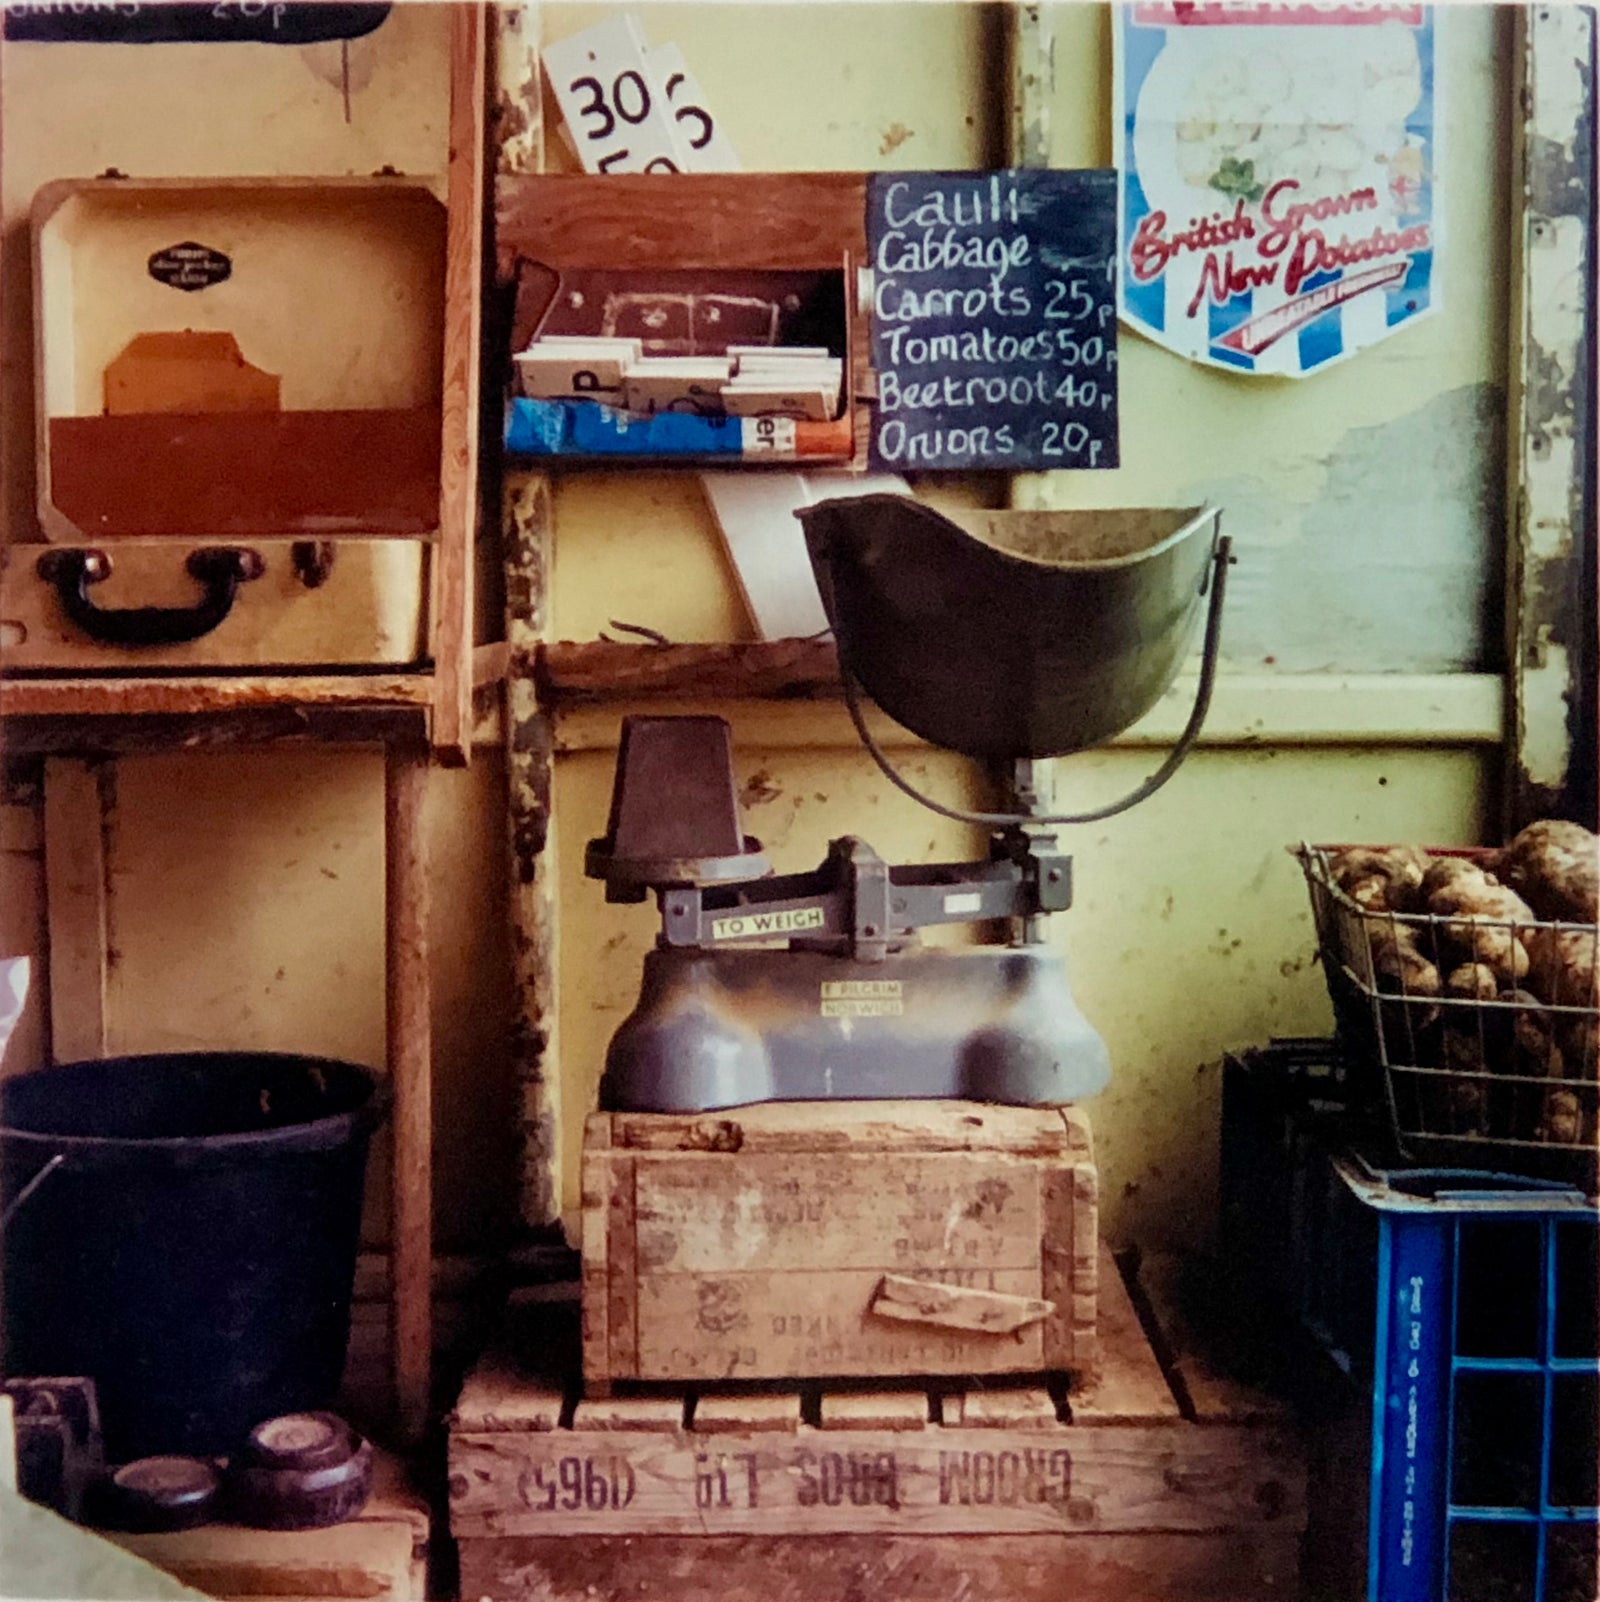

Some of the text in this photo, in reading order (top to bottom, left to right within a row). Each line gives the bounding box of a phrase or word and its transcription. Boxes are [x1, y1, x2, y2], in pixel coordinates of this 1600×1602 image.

[570, 70, 651, 139] 30
[877, 227, 1032, 282] Cabbage
[1130, 178, 1379, 281] British Grown
[1284, 223, 1431, 296] Potatoes
[875, 273, 1114, 327] Carrots 25p
[880, 326, 1118, 372] Tomatoes 50p
[878, 370, 1113, 412] Beetroot 40p
[877, 413, 1103, 467] Onions 20p
[717, 909, 821, 935] TO WEIGH
[517, 1455, 636, 1512] (1965)
[938, 1447, 1072, 1506] GROOM
